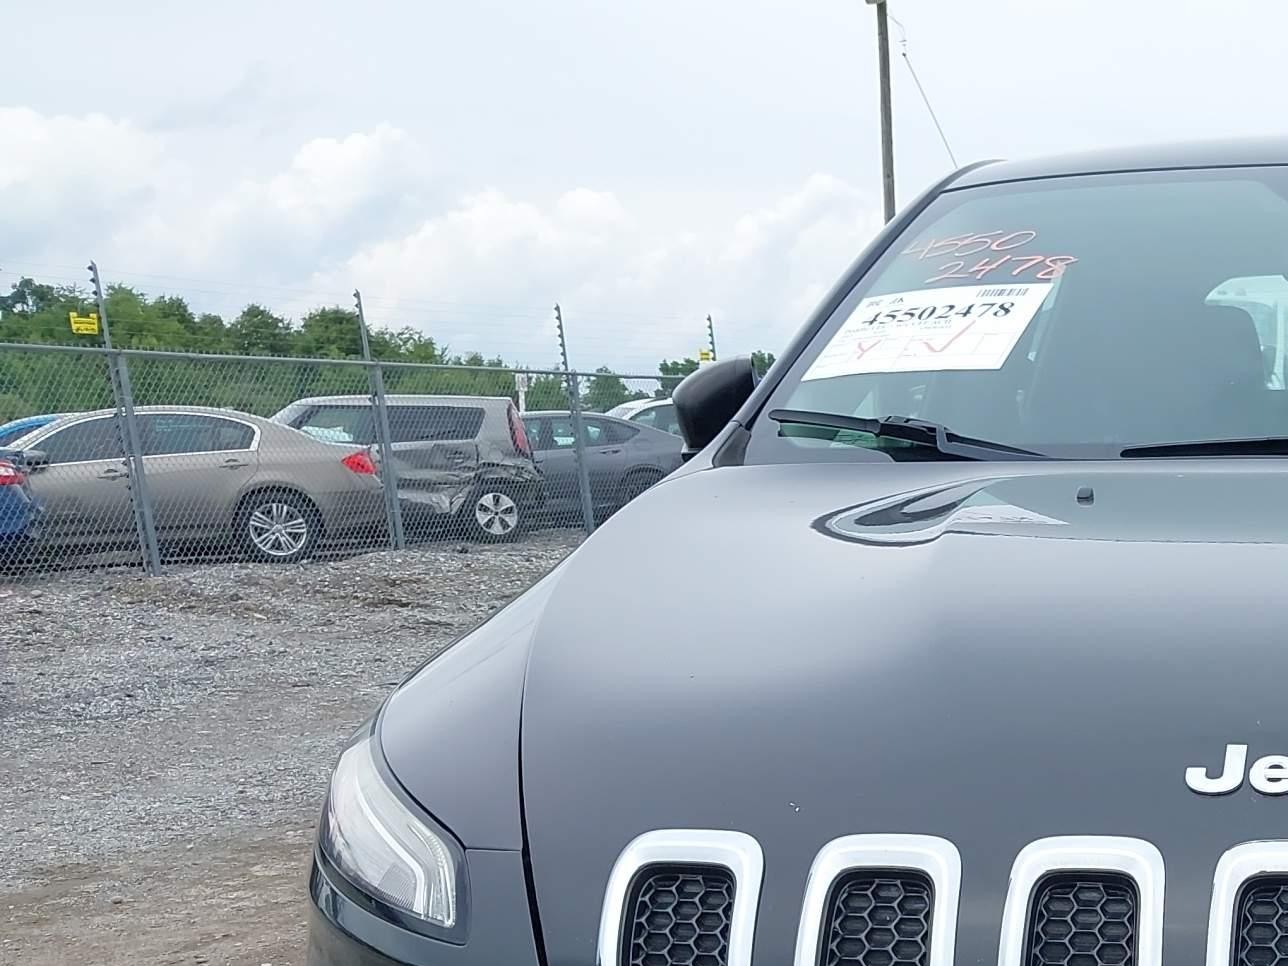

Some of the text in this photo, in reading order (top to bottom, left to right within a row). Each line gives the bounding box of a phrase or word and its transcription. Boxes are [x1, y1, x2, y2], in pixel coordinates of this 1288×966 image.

[901, 230, 1037, 260] 4550
[924, 254, 1080, 284] 2478
[861, 301, 1015, 327] 45502478
